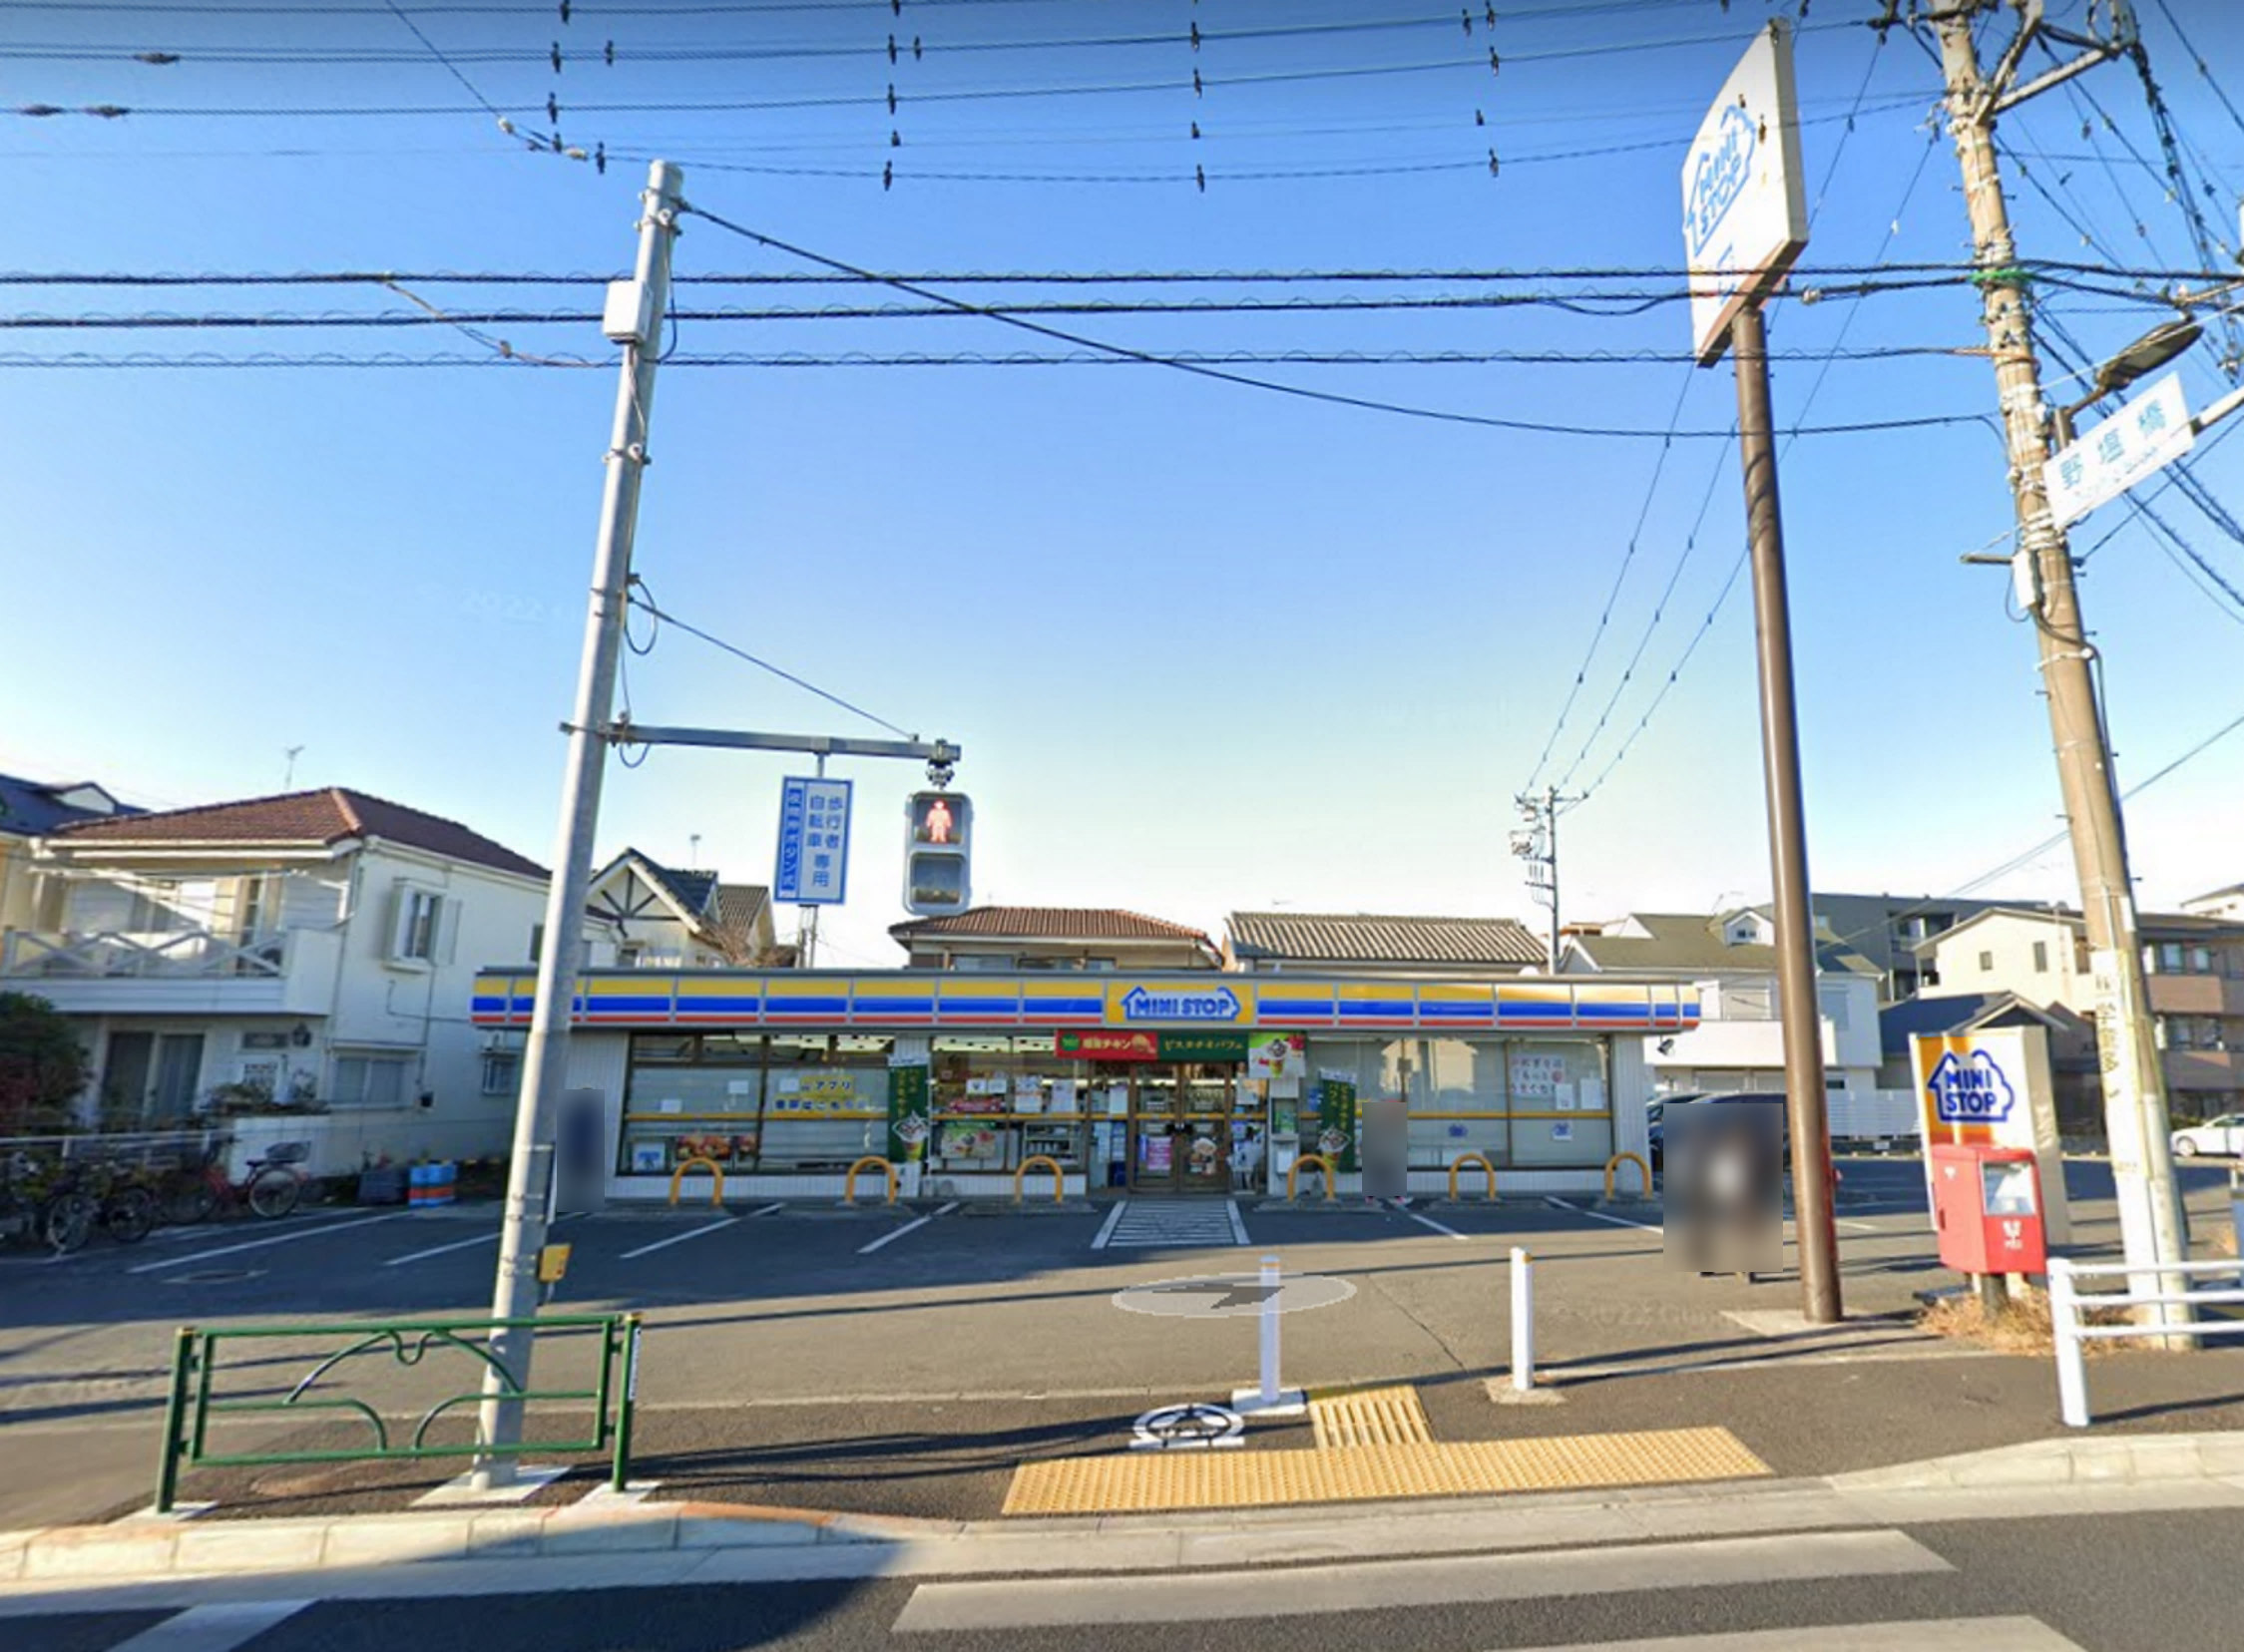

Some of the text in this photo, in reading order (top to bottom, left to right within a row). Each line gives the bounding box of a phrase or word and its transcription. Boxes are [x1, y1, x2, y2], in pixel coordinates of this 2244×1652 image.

[1699, 127, 1738, 201] MINI
[1700, 154, 1741, 235] STOP
[807, 796, 824, 846] 自転車
[825, 796, 842, 848] 歩行者
[1134, 998, 1229, 1016] MINI STOP
[1945, 1092, 1996, 1113] STOP
[1947, 1067, 1993, 1089] MINI
